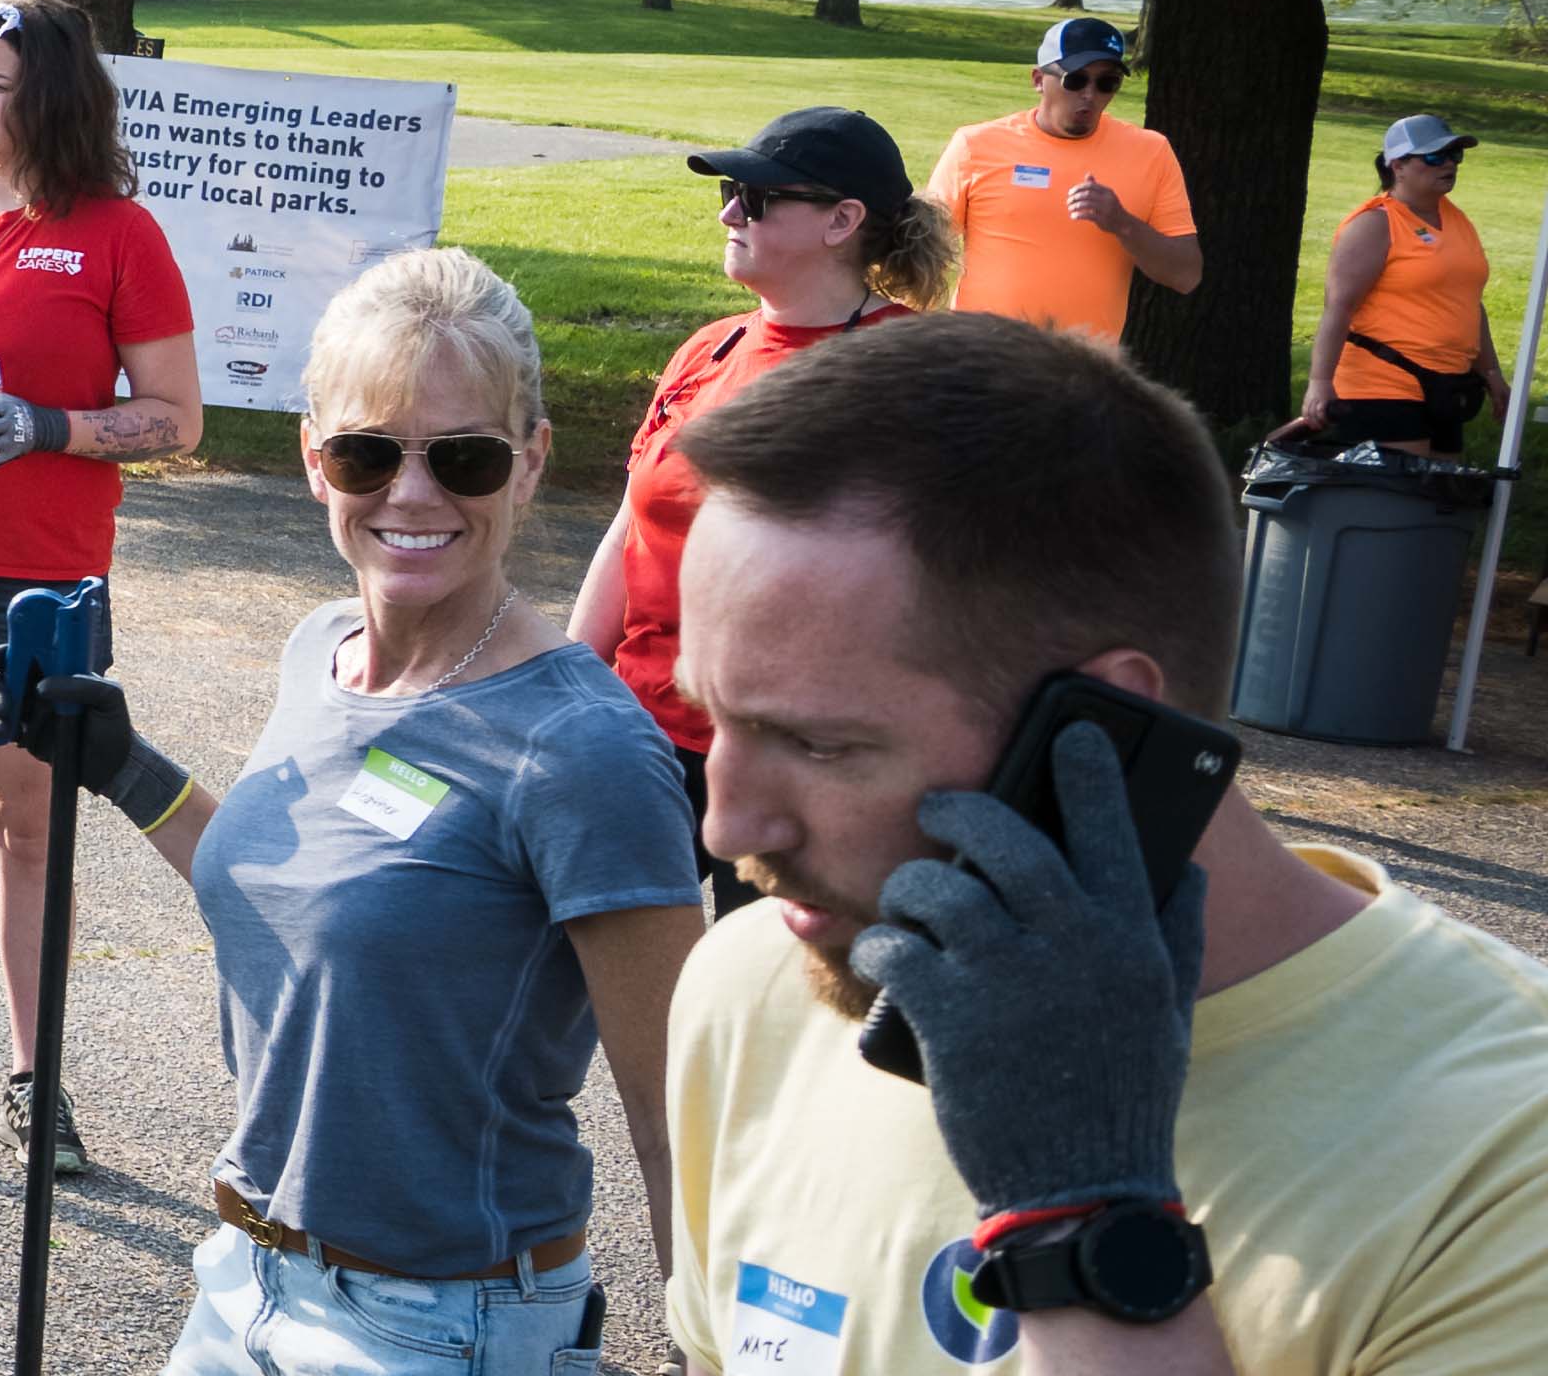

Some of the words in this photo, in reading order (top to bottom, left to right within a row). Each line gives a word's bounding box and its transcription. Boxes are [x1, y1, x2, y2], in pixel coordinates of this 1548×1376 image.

[121, 87, 165, 112] VIA
[173, 92, 302, 128] Emerging
[310, 105, 422, 132] Leaders
[169, 124, 246, 149] wants
[255, 130, 279, 150] to
[287, 132, 365, 158] thank
[132, 149, 202, 176] ustry
[208, 153, 247, 176] for
[254, 161, 351, 190] coming
[359, 167, 385, 188] to
[147, 180, 193, 200] our
[201, 181, 263, 207] local
[270, 187, 357, 215] parks.
[15, 258, 65, 272] CARES
[18, 247, 84, 264] LIPPERT
[244, 267, 287, 279] PATRICK
[236, 291, 272, 308] RDI
[388, 760, 429, 787] HELLO
[767, 1274, 817, 1308] HELLO
